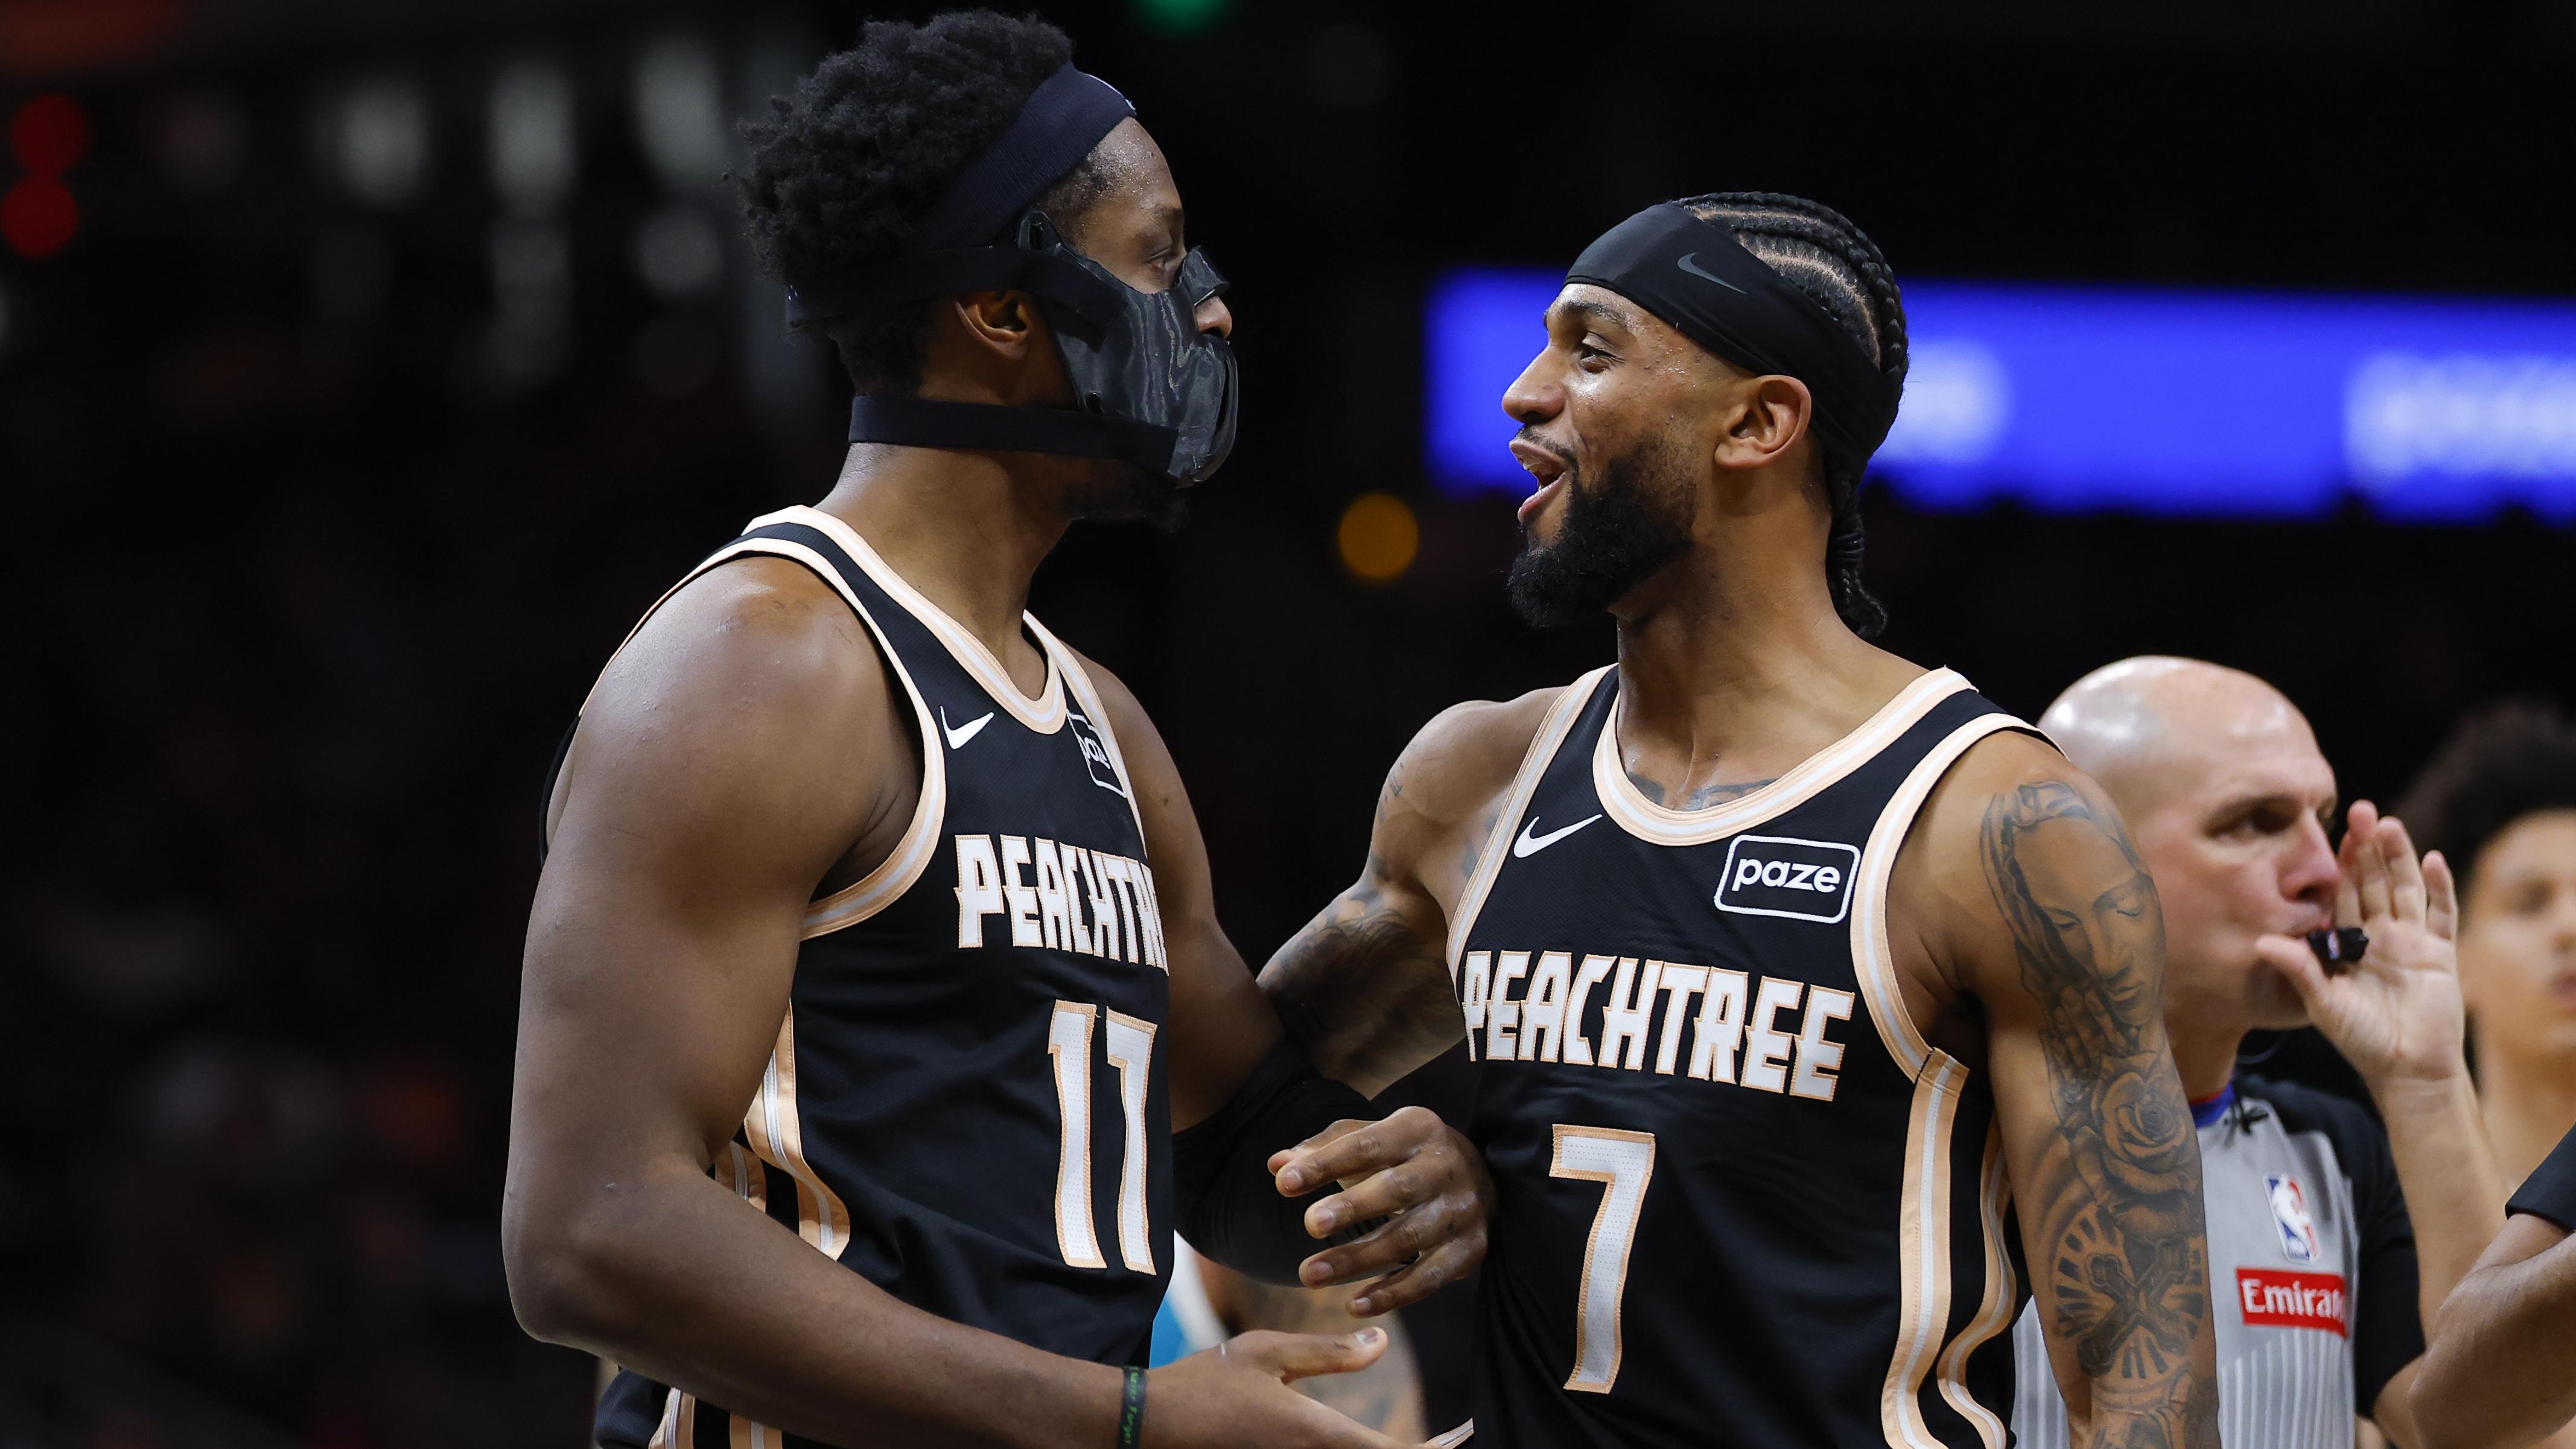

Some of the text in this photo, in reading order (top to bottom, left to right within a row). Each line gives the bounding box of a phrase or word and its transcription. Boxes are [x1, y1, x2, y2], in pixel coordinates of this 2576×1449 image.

[953, 833, 1169, 976] PEACHTR
[1731, 858, 1841, 893] paze
[1462, 951, 1856, 1101] PEACHTREE
[1048, 999, 1158, 1276] 17
[1549, 1124, 1656, 1395] 7
